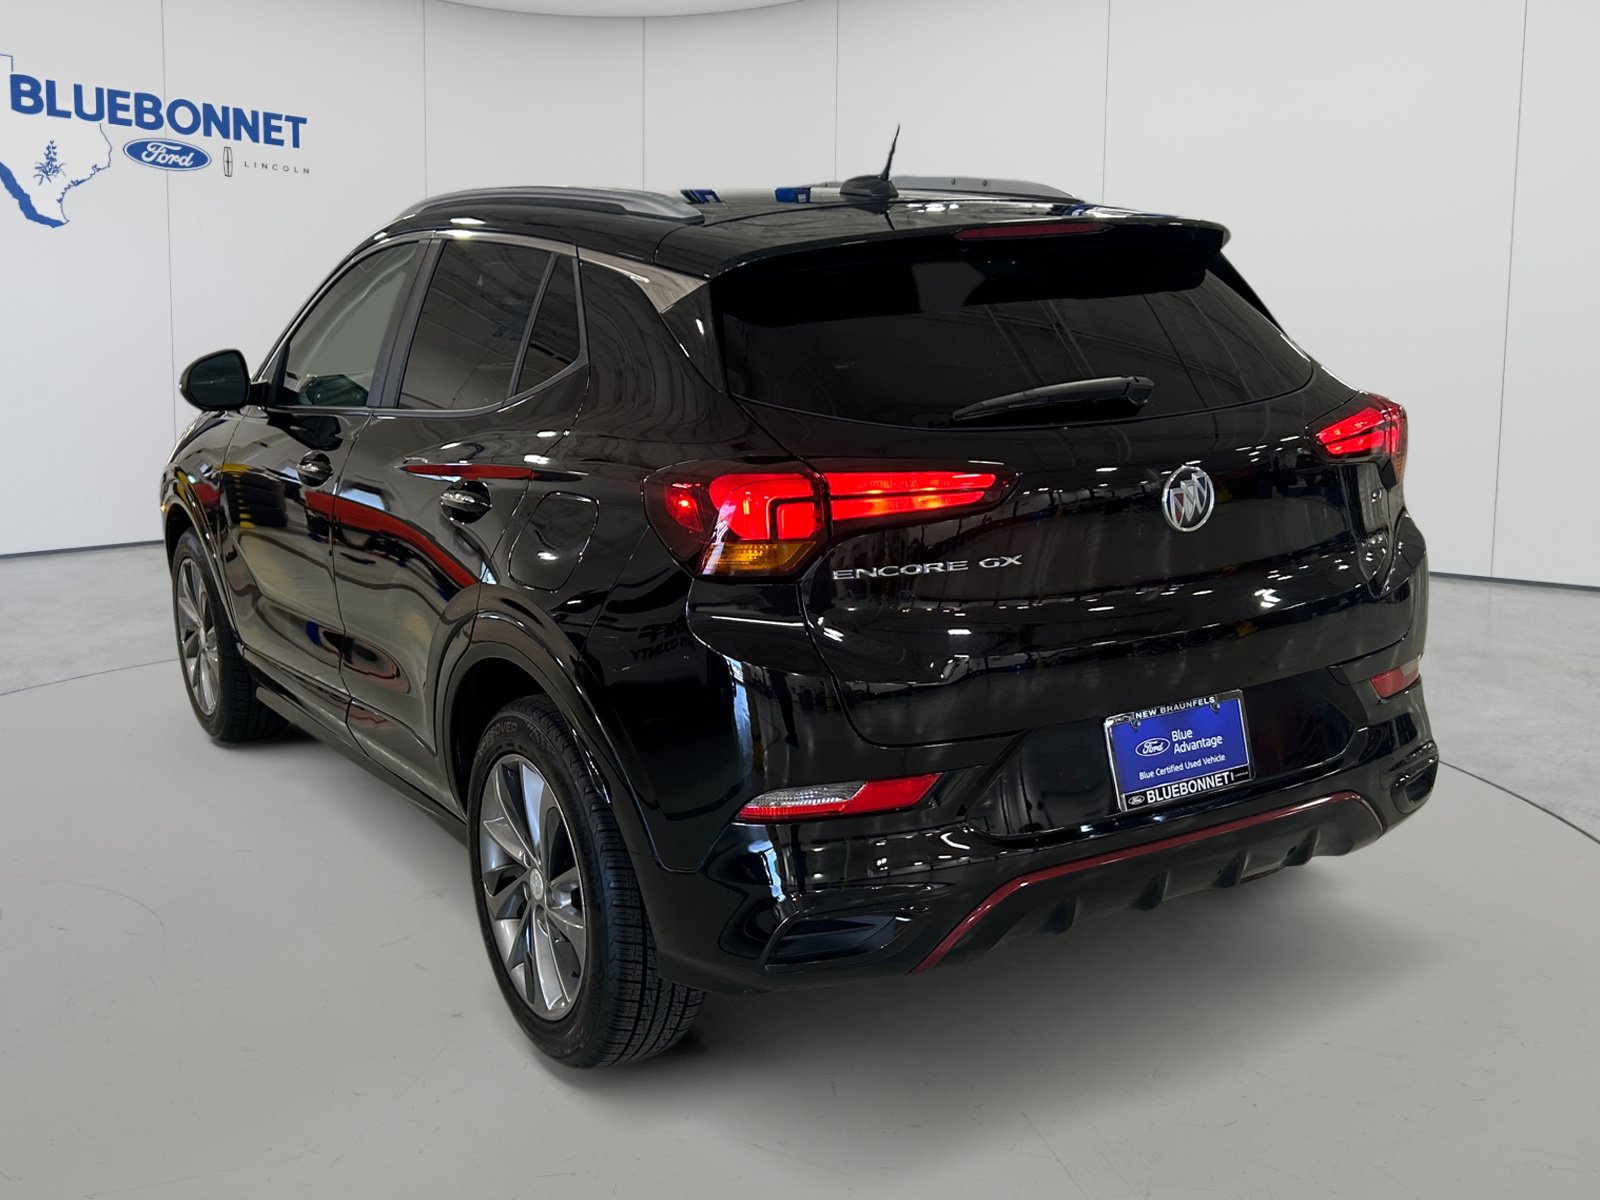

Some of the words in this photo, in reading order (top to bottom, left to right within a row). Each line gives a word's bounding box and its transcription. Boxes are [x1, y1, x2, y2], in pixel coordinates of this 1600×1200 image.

[9, 73, 308, 149] BLUEBONNET
[141, 141, 194, 169] Ford
[243, 160, 311, 175] LINCOLN
[832, 560, 969, 580] ENCORE
[978, 554, 1023, 569] GX
[1135, 708, 1157, 719] NEW
[1160, 696, 1216, 713] BRAUNFELS
[1142, 740, 1164, 755] Ford
[1171, 729, 1193, 742] Blue
[1173, 735, 1223, 755] Advantage
[1138, 770, 1155, 780] Blue
[1155, 762, 1184, 776] Certified
[1184, 758, 1202, 770] Used
[1202, 753, 1226, 766] Vehicle
[1146, 771, 1230, 804] BLUEBONNET
